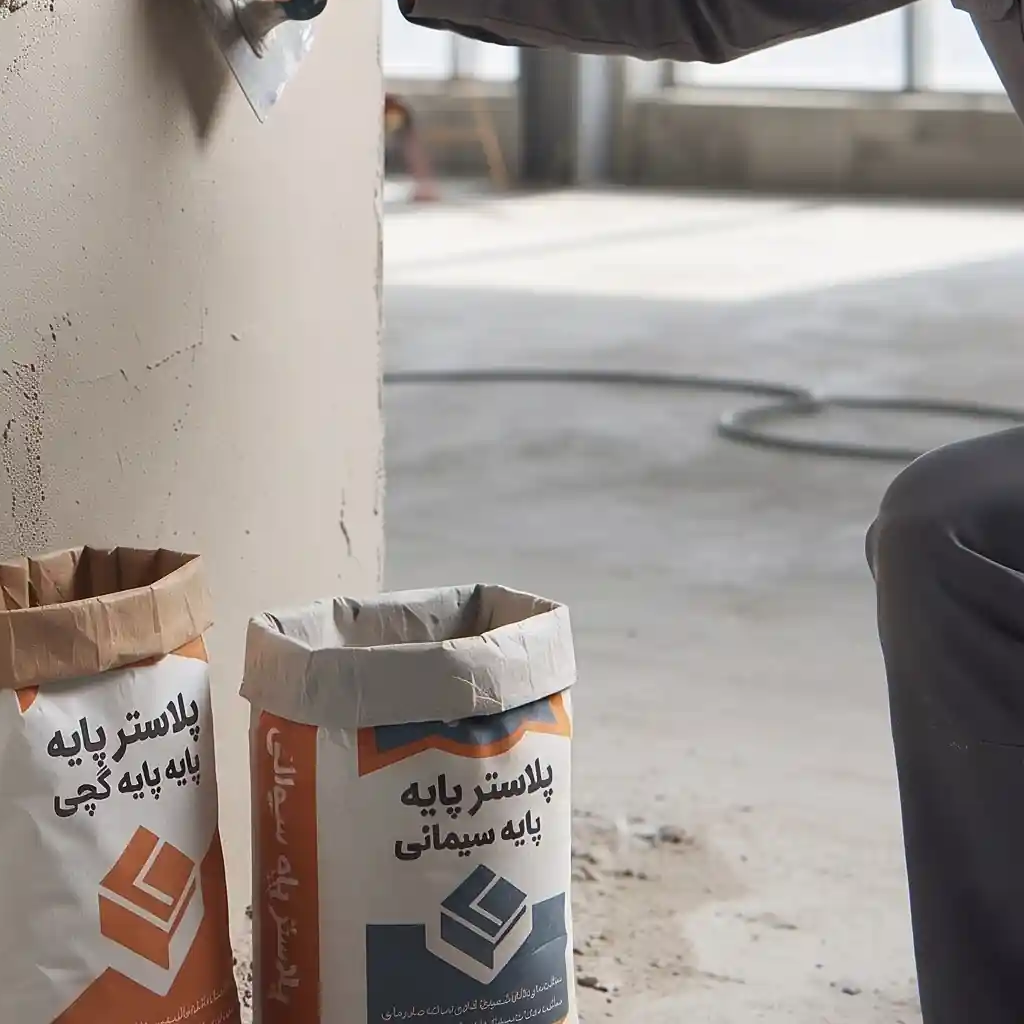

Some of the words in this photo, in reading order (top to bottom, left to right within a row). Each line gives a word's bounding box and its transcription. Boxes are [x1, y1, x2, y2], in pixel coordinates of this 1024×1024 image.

[47, 717, 107, 767] پایه
[112, 692, 200, 763] پلاستر
[117, 760, 162, 800] پایه
[165, 747, 200, 785] پایه
[467, 758, 554, 817] پلاستر
[54, 765, 112, 818] گچی
[401, 774, 463, 819] پایه
[394, 823, 496, 861] سیمانی
[501, 810, 542, 847] پایه
